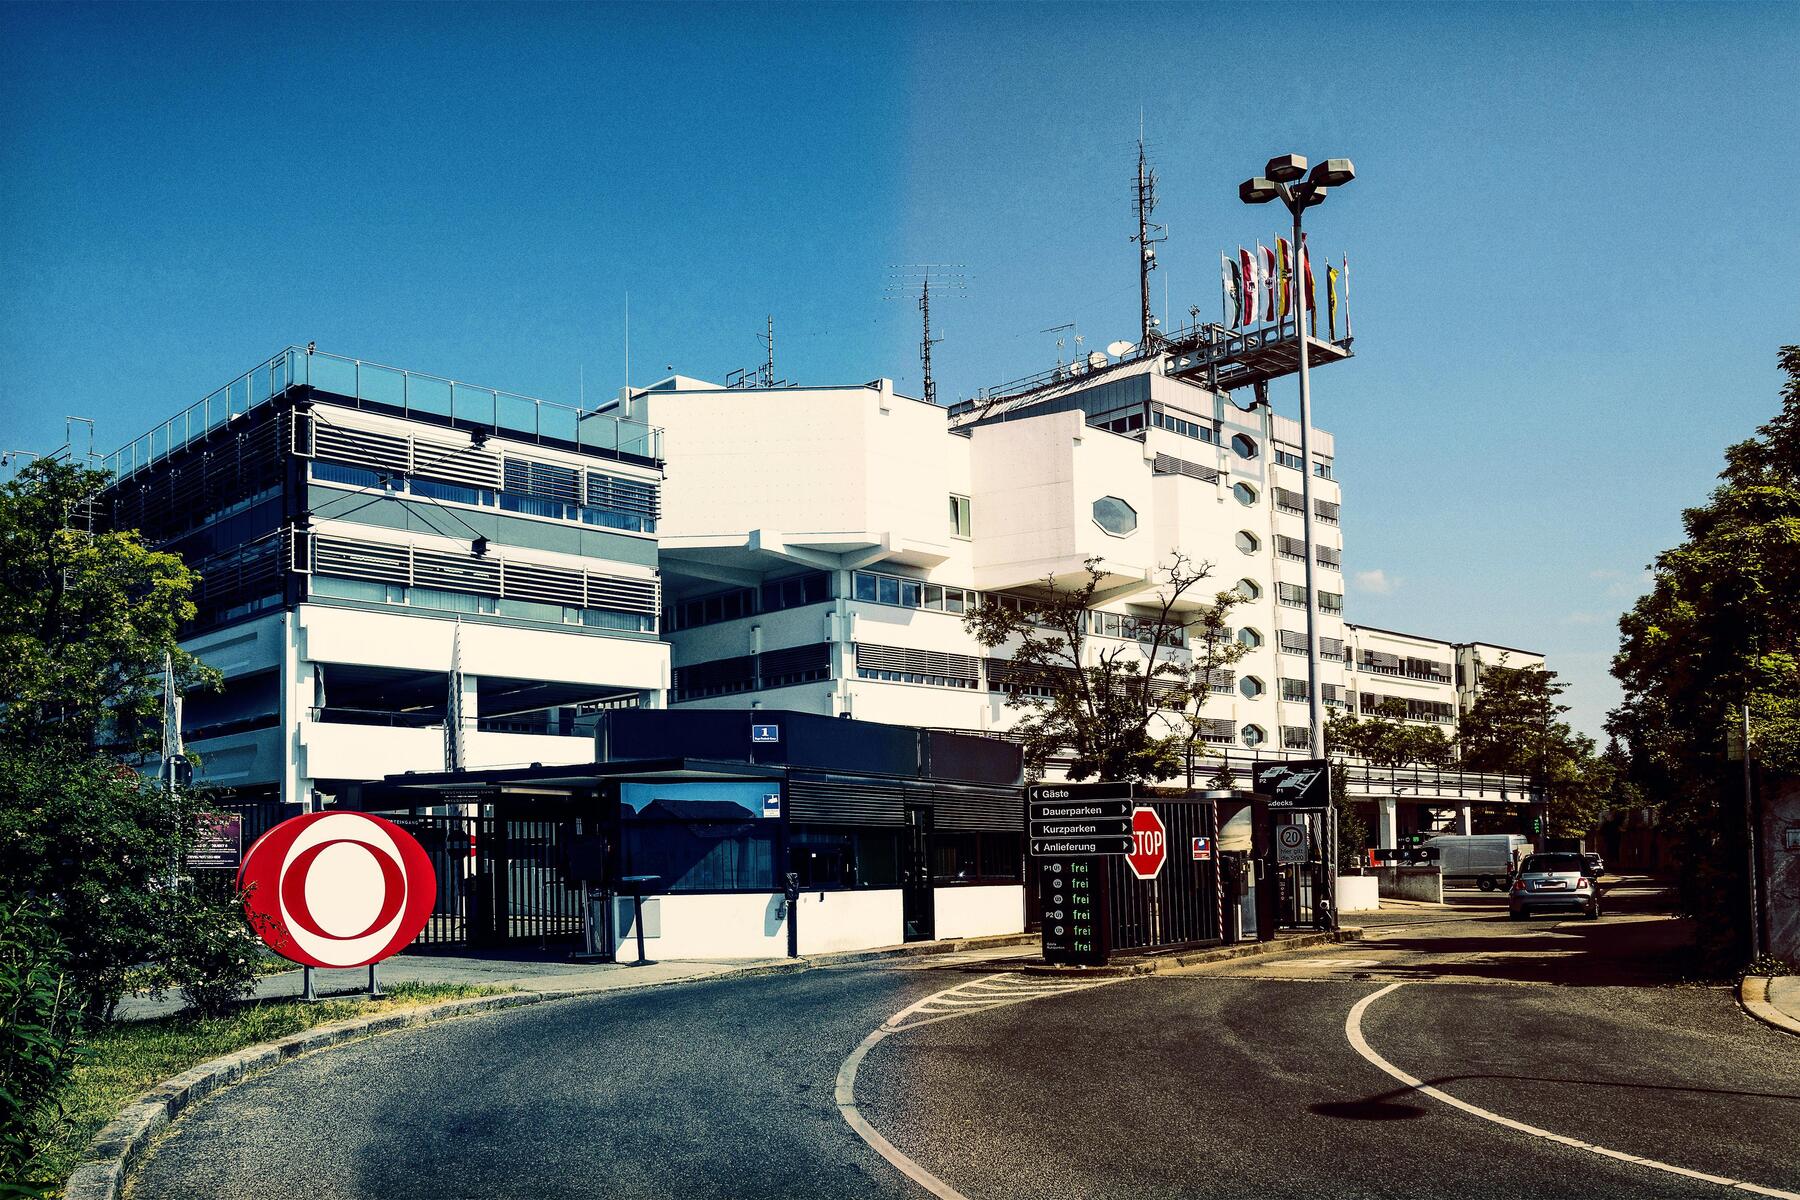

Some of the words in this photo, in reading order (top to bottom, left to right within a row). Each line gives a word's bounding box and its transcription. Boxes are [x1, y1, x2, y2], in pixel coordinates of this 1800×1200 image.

[761, 727, 769, 737] 1
[1042, 789, 1070, 798] Gäste
[1042, 806, 1102, 817] Dauerparken
[1043, 824, 1096, 835] Kurzparken
[1285, 831, 1298, 843] 20
[1043, 842, 1096, 853] Anlieferung
[1071, 862, 1088, 873] frei
[1072, 878, 1089, 889] frei
[1072, 893, 1089, 904] frei
[1073, 909, 1090, 920] frei
[1074, 925, 1091, 936] frei
[1074, 941, 1091, 952] frei
